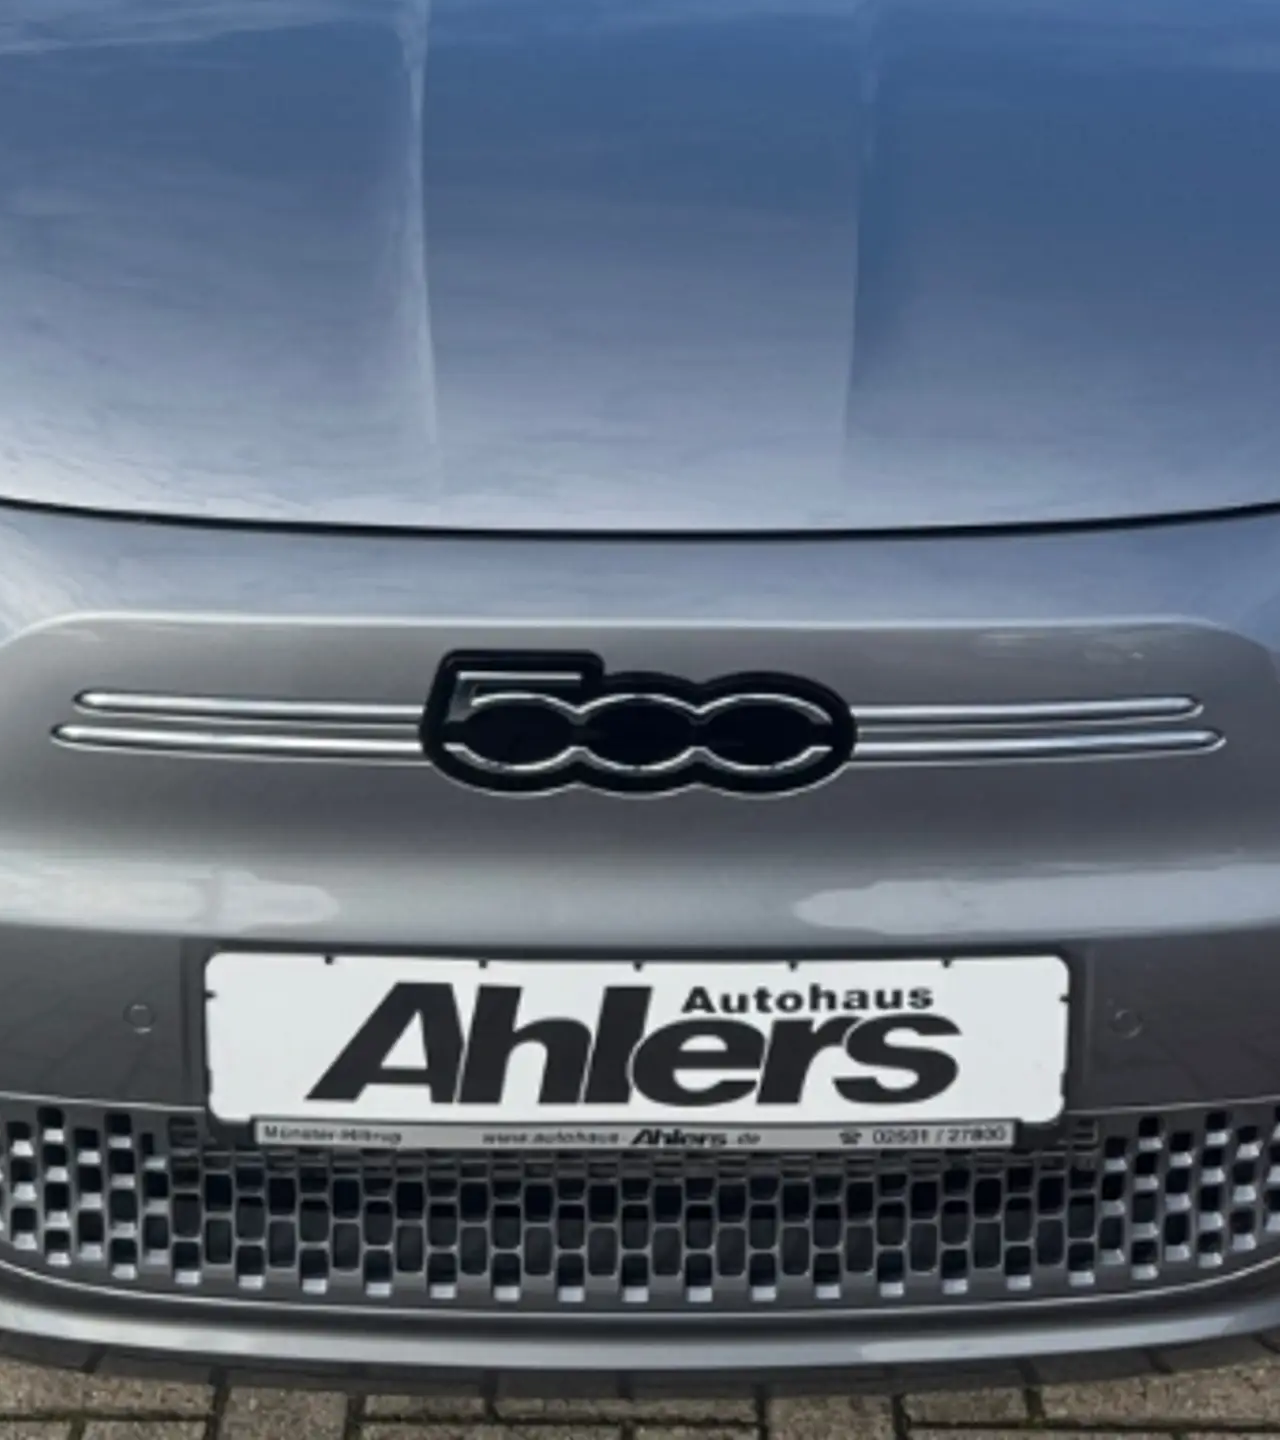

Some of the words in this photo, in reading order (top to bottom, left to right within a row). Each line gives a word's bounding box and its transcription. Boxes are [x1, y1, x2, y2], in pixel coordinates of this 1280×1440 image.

[434, 660, 844, 782] 500
[304, 980, 963, 1107] Ahlers
[681, 984, 934, 1015] Autohaus
